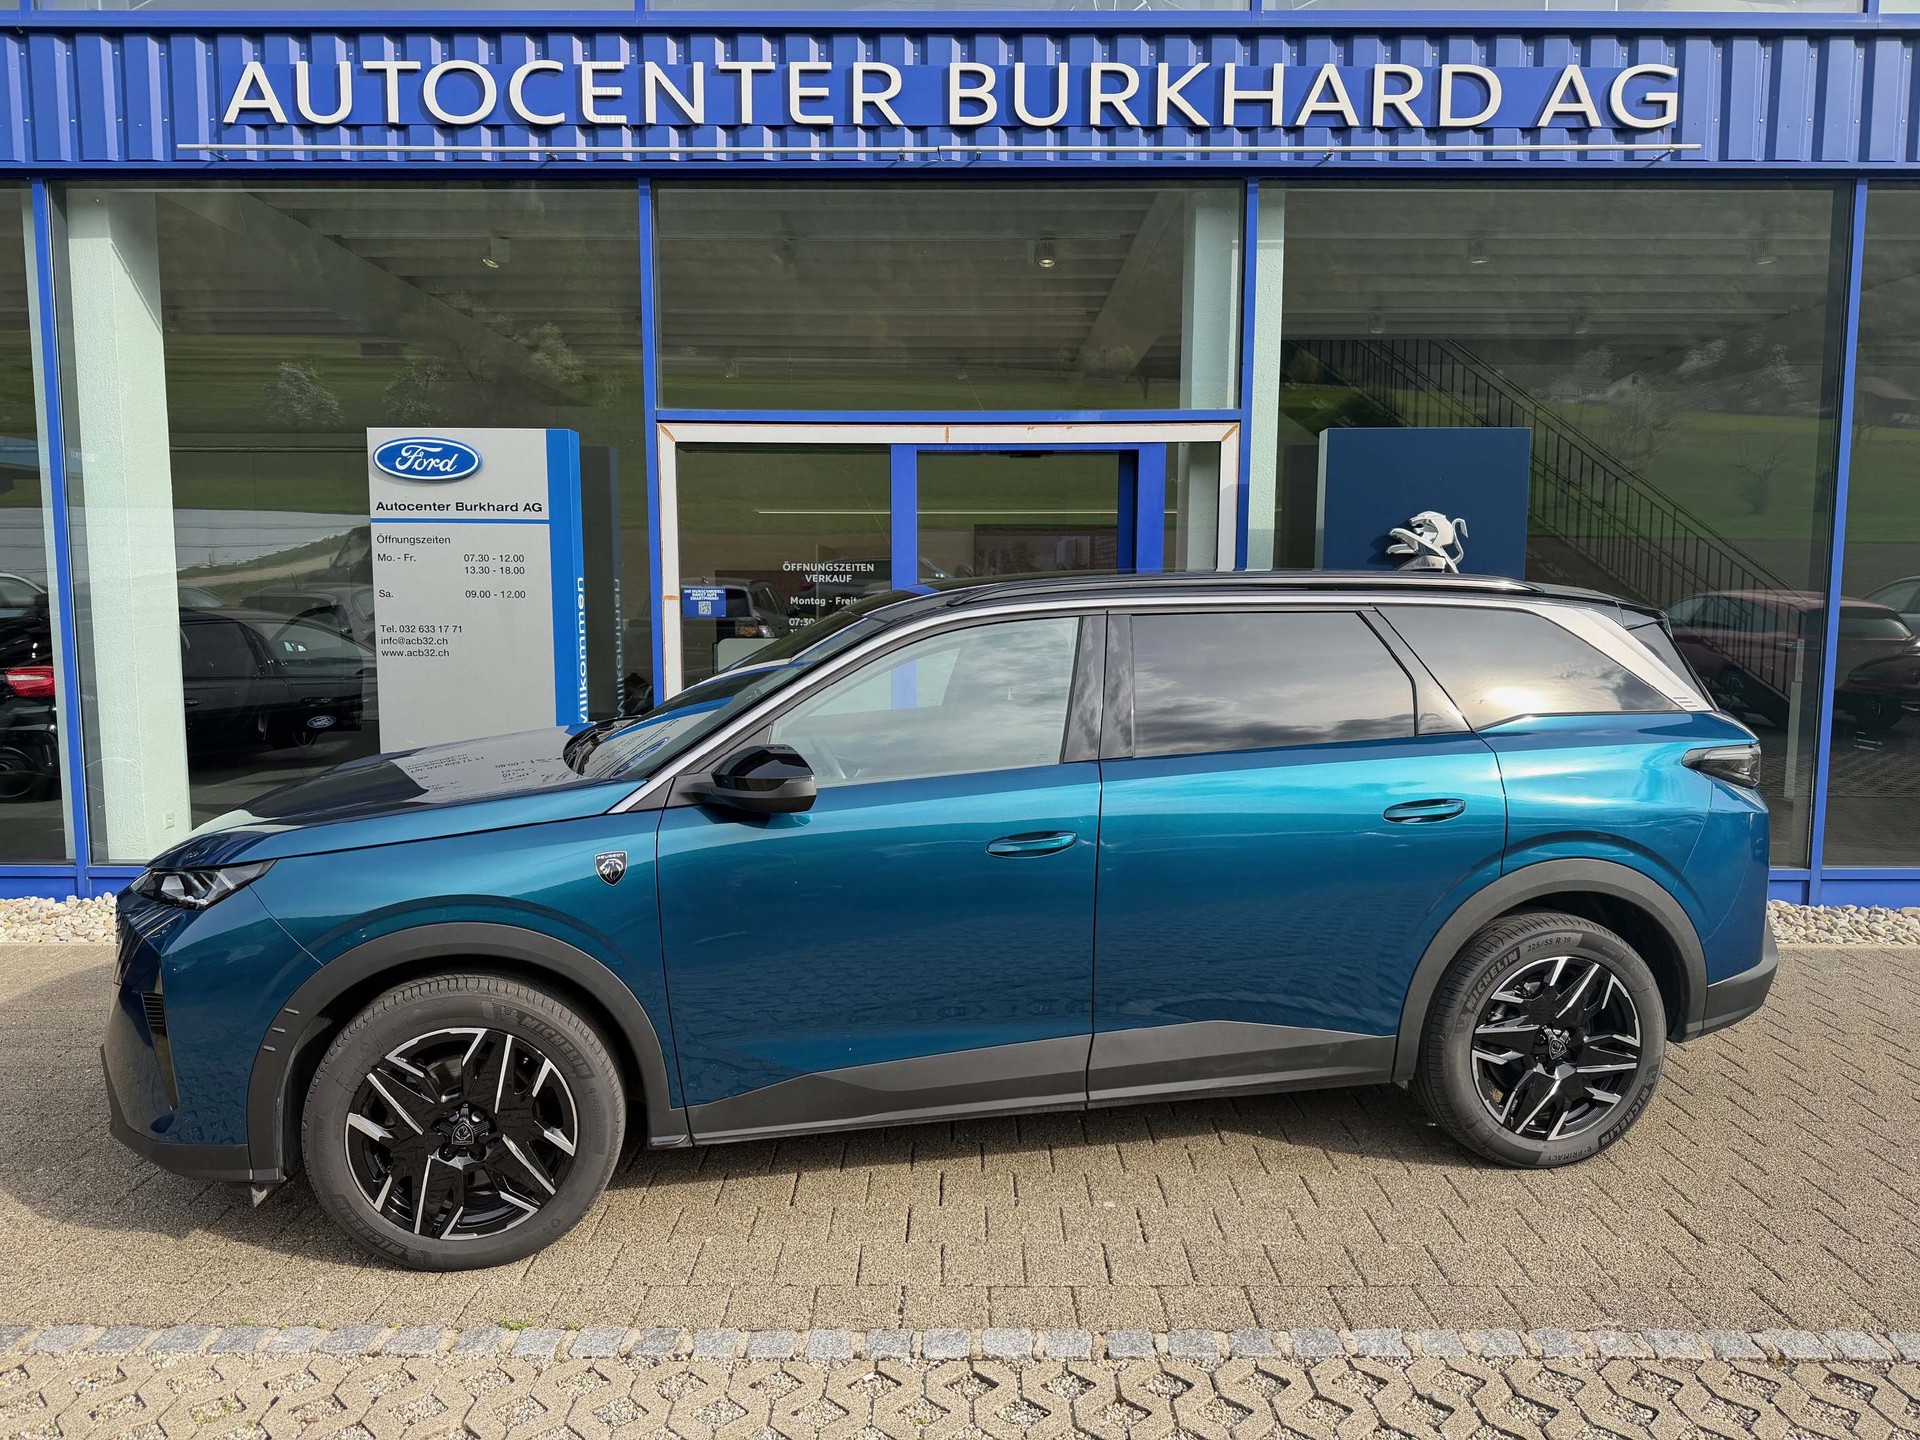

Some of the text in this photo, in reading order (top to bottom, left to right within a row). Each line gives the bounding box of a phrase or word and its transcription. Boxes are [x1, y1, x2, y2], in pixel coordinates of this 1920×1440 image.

[223, 61, 1679, 130] AUTOCENTER BURKHARD AG
[395, 444, 459, 473] Ford
[375, 501, 543, 514] Autocenter Burkhard AG
[376, 532, 451, 546] Öffnungszeiten
[377, 553, 396, 562] Mo.
[403, 553, 417, 562] Fr.
[463, 553, 490, 563] 07.30
[498, 553, 525, 563] 12.00
[464, 565, 491, 575] 13.30
[499, 565, 526, 575] 18.00
[782, 561, 875, 572] ÖFFNUNGSZEITEN
[805, 574, 853, 583] VERKAUF
[378, 589, 394, 598] Sa.
[464, 589, 491, 599] 09.00
[500, 589, 526, 599] 12.00
[790, 596, 825, 607] Montag
[788, 617, 815, 626] 07:30
[380, 624, 462, 634] Tel. 032 633 17 71
[380, 636, 449, 646] info@acb32.ch
[381, 648, 450, 657] www.acb32.ch
[1465, 950, 1519, 1012] MICHELIN
[520, 1016, 592, 1078] MICHELIN
[1600, 1087, 1650, 1145] MICHELIN
